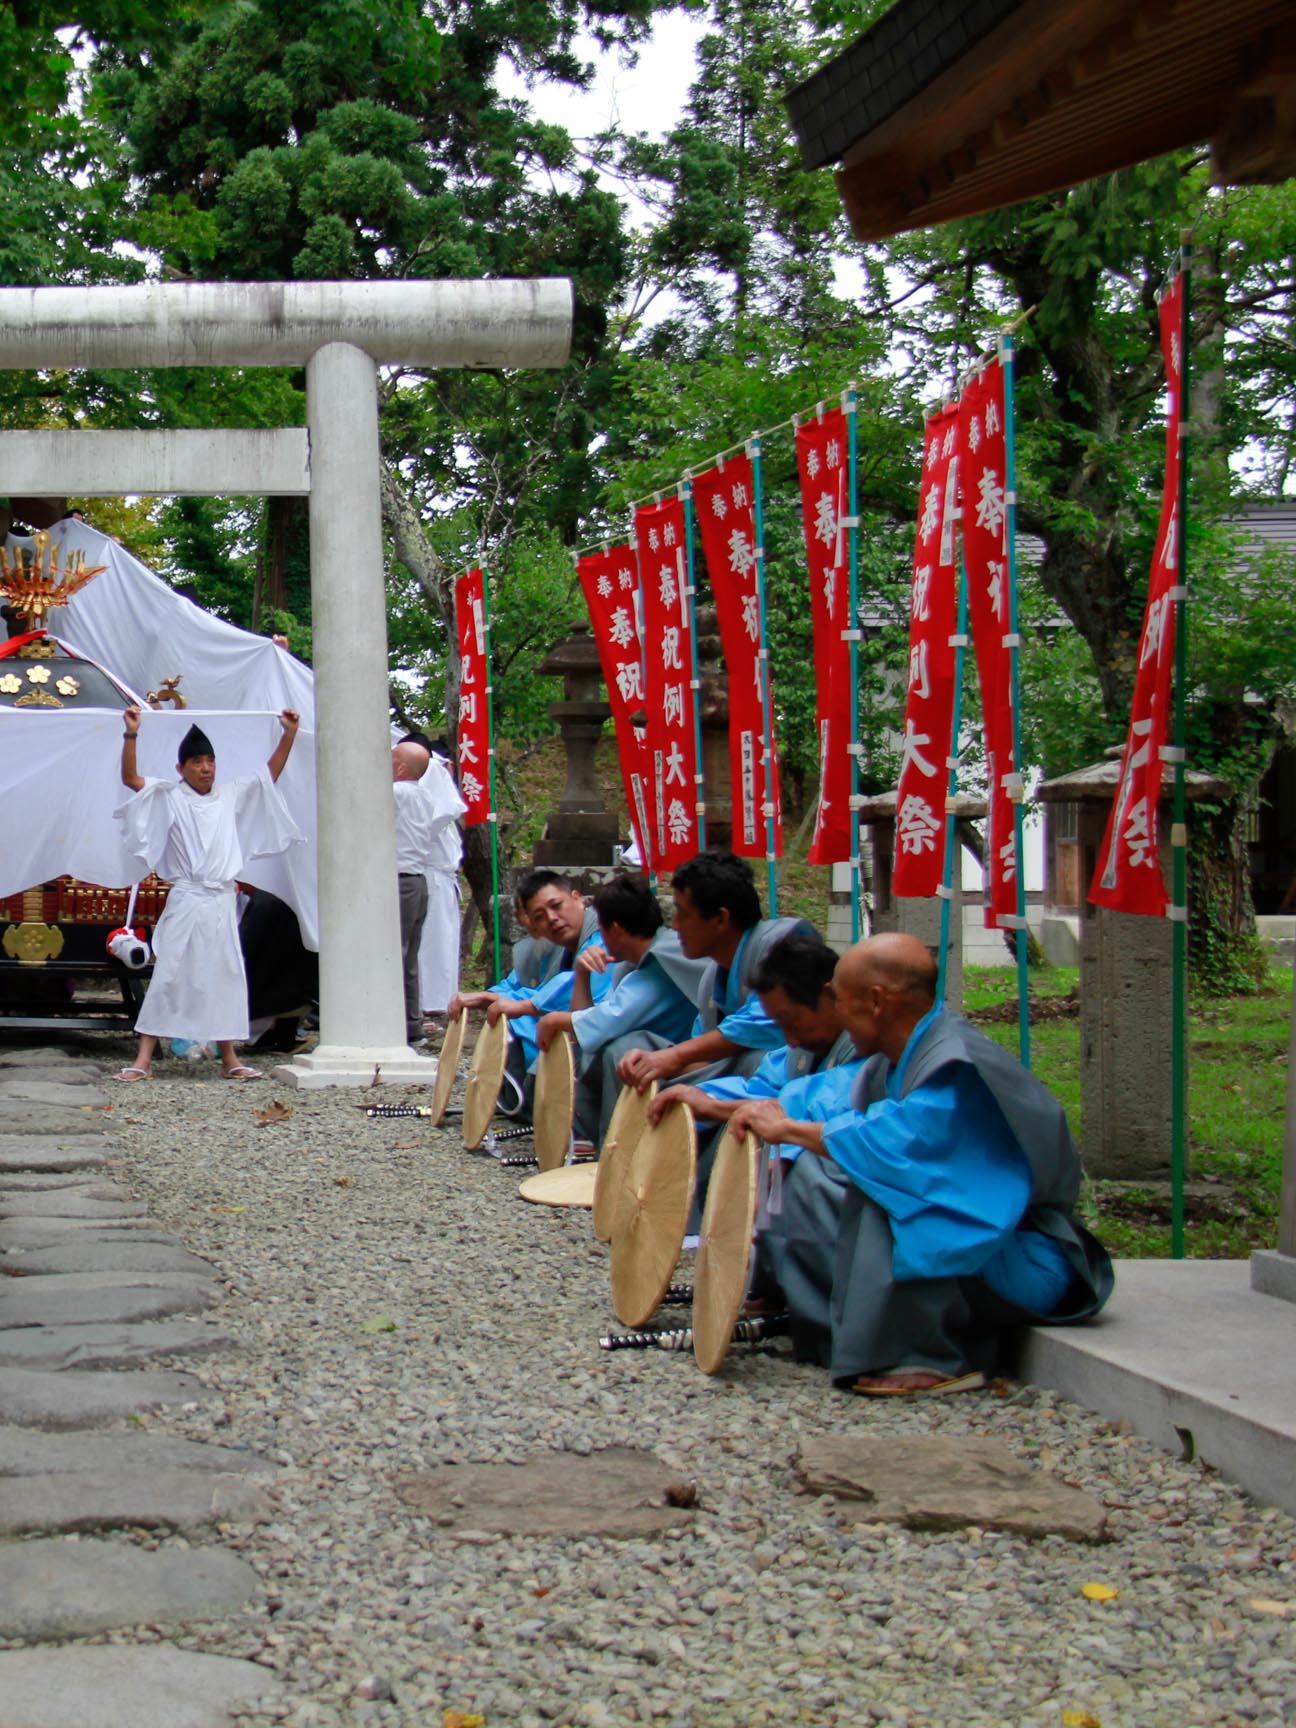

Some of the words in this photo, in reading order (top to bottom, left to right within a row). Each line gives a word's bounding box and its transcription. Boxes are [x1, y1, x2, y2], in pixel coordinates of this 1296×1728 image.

[968, 398, 1000, 454] 奉納
[807, 438, 840, 480] 奉納
[926, 425, 954, 472] 奉納
[711, 481, 748, 521] 奉納
[648, 521, 676, 554] 奉納
[597, 566, 634, 600] 奉納
[659, 563, 693, 846] 奉祝例大祭
